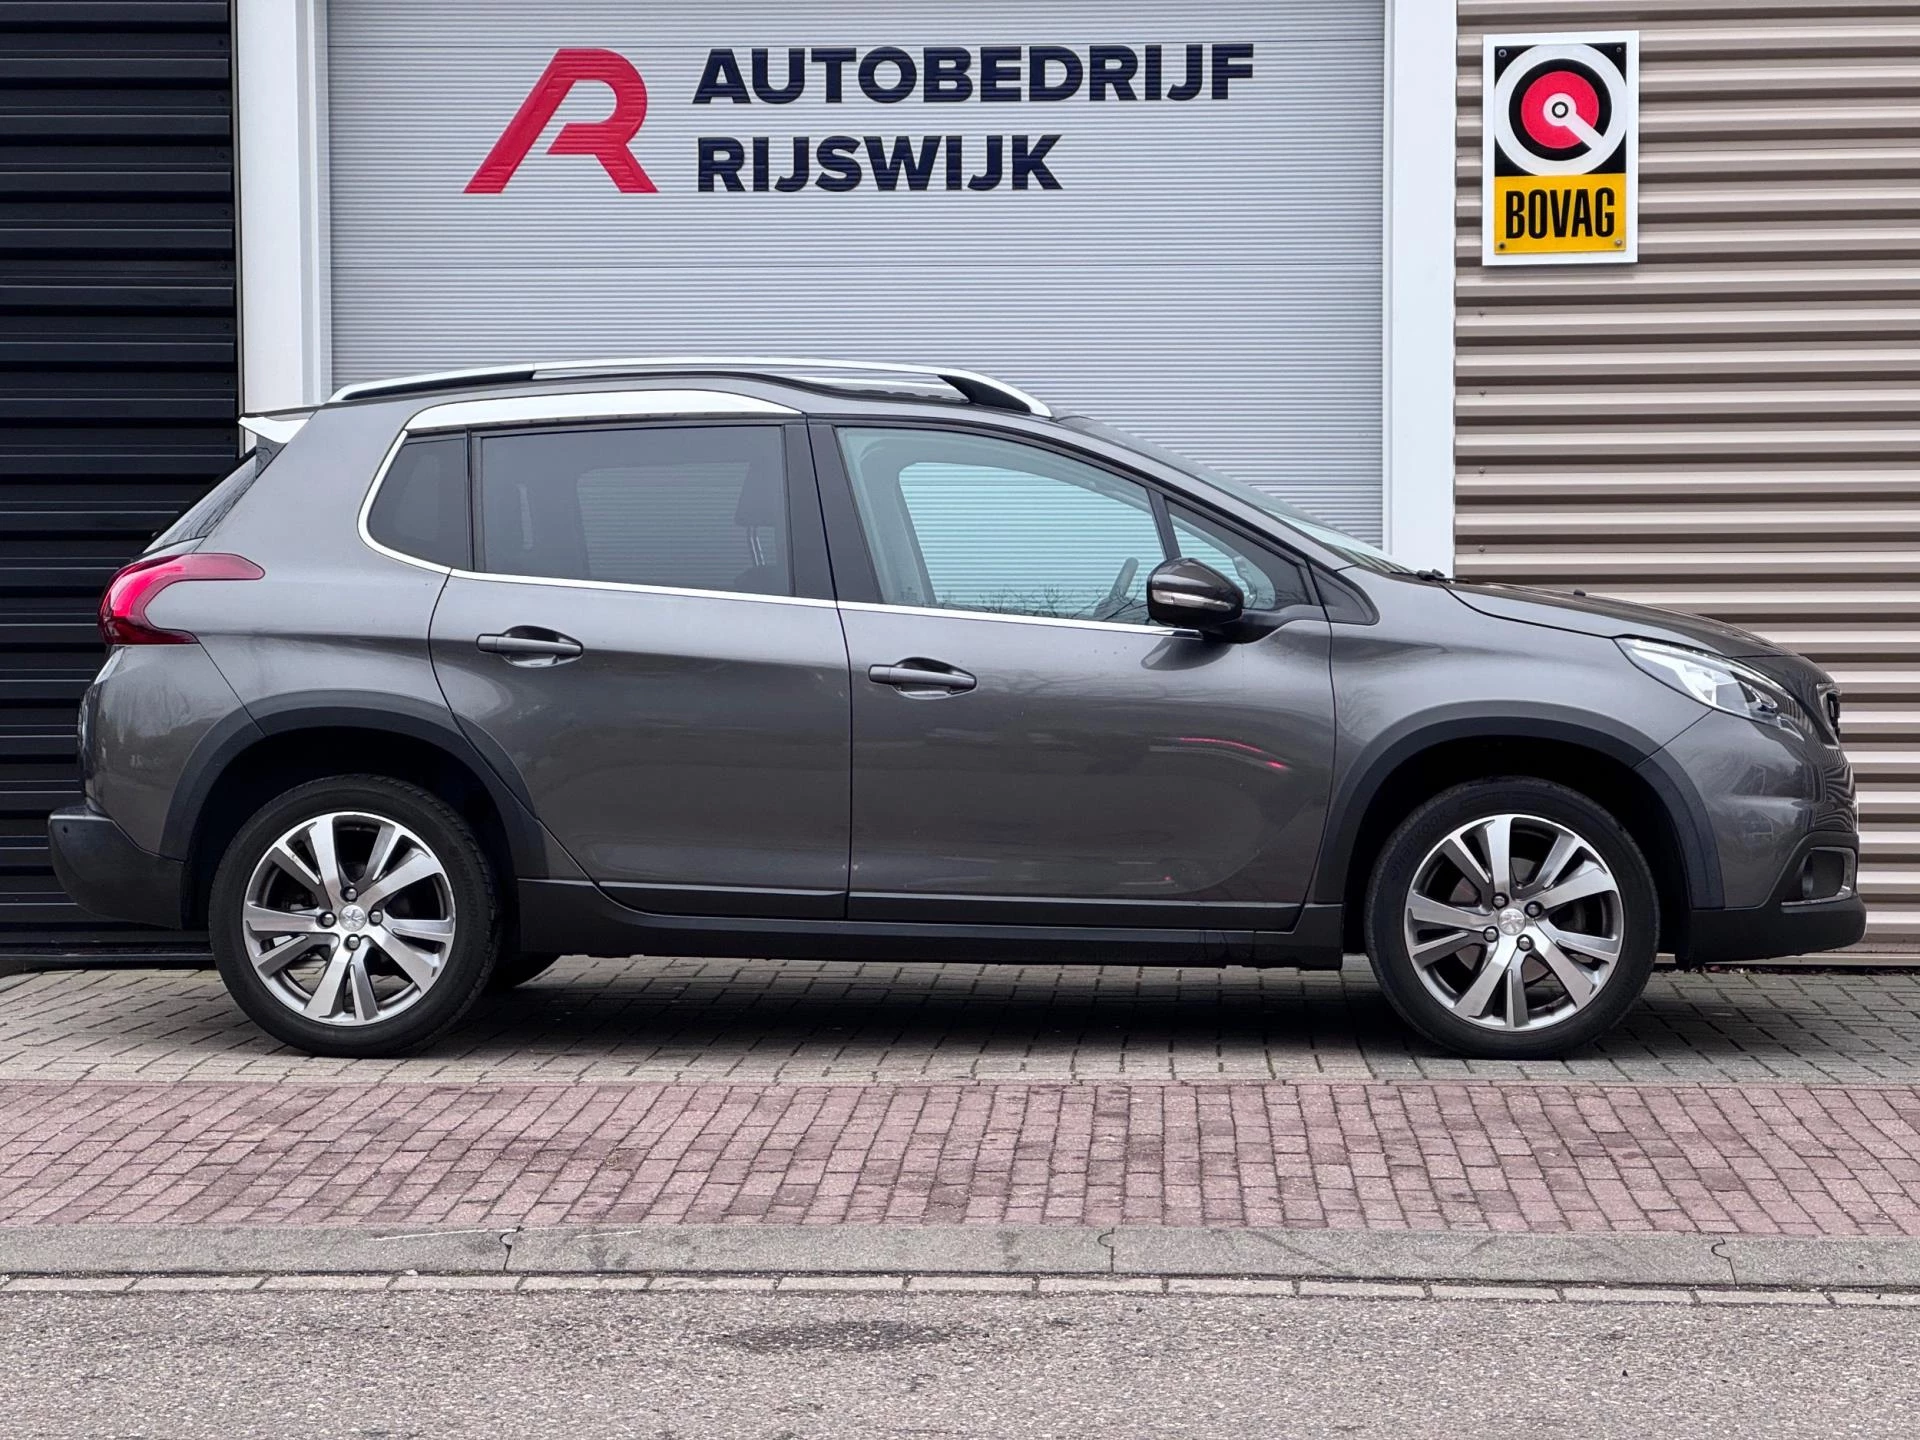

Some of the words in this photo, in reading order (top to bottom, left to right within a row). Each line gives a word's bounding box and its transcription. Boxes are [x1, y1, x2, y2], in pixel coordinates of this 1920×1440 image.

[692, 44, 1254, 105] AUTOBEDRIJF
[697, 135, 1064, 193] RIJSWIJK
[1505, 187, 1615, 240] BOVAG
